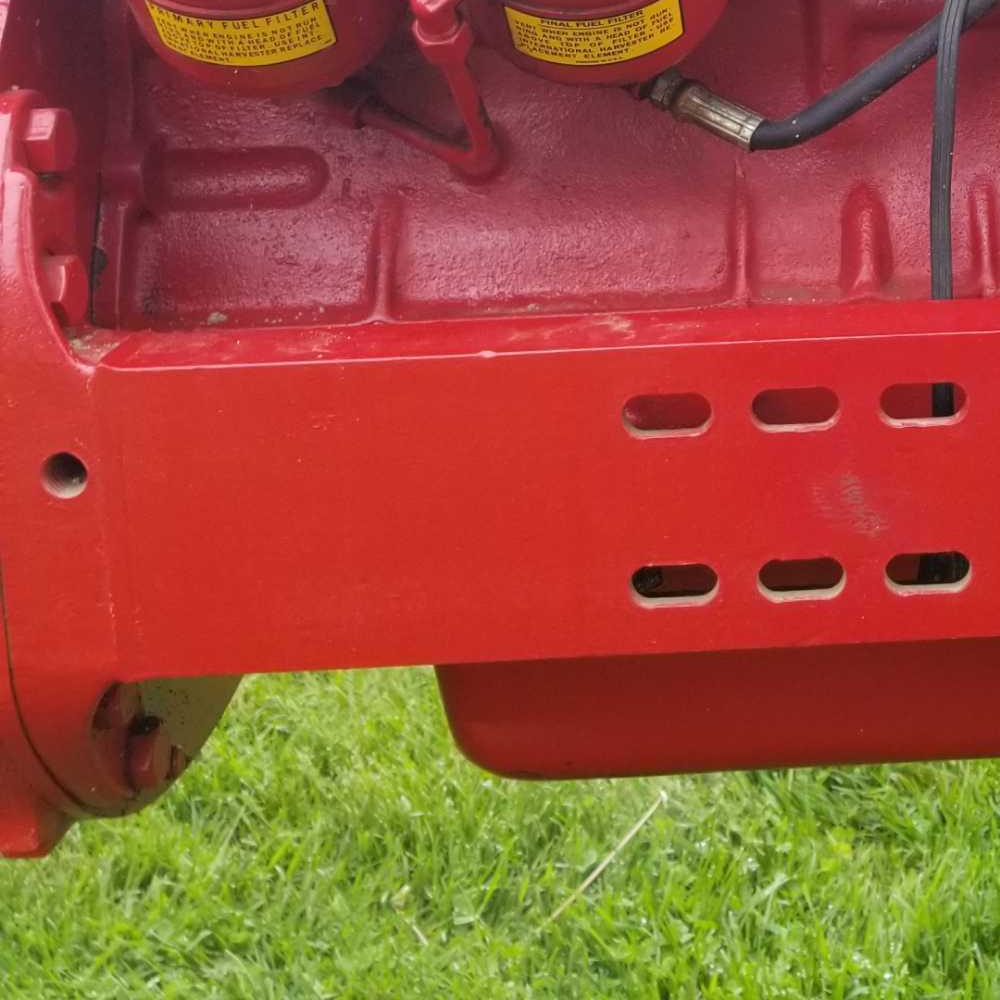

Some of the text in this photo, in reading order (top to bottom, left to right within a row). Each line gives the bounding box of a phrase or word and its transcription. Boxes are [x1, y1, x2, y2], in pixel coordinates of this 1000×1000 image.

[222, 20, 260, 29] FUEL
[265, 3, 319, 25] FILTER
[540, 19, 570, 27] FINAL
[608, 11, 642, 23] FILTER
[627, 20, 644, 28] NOT
[606, 30, 630, 39] HEAD
